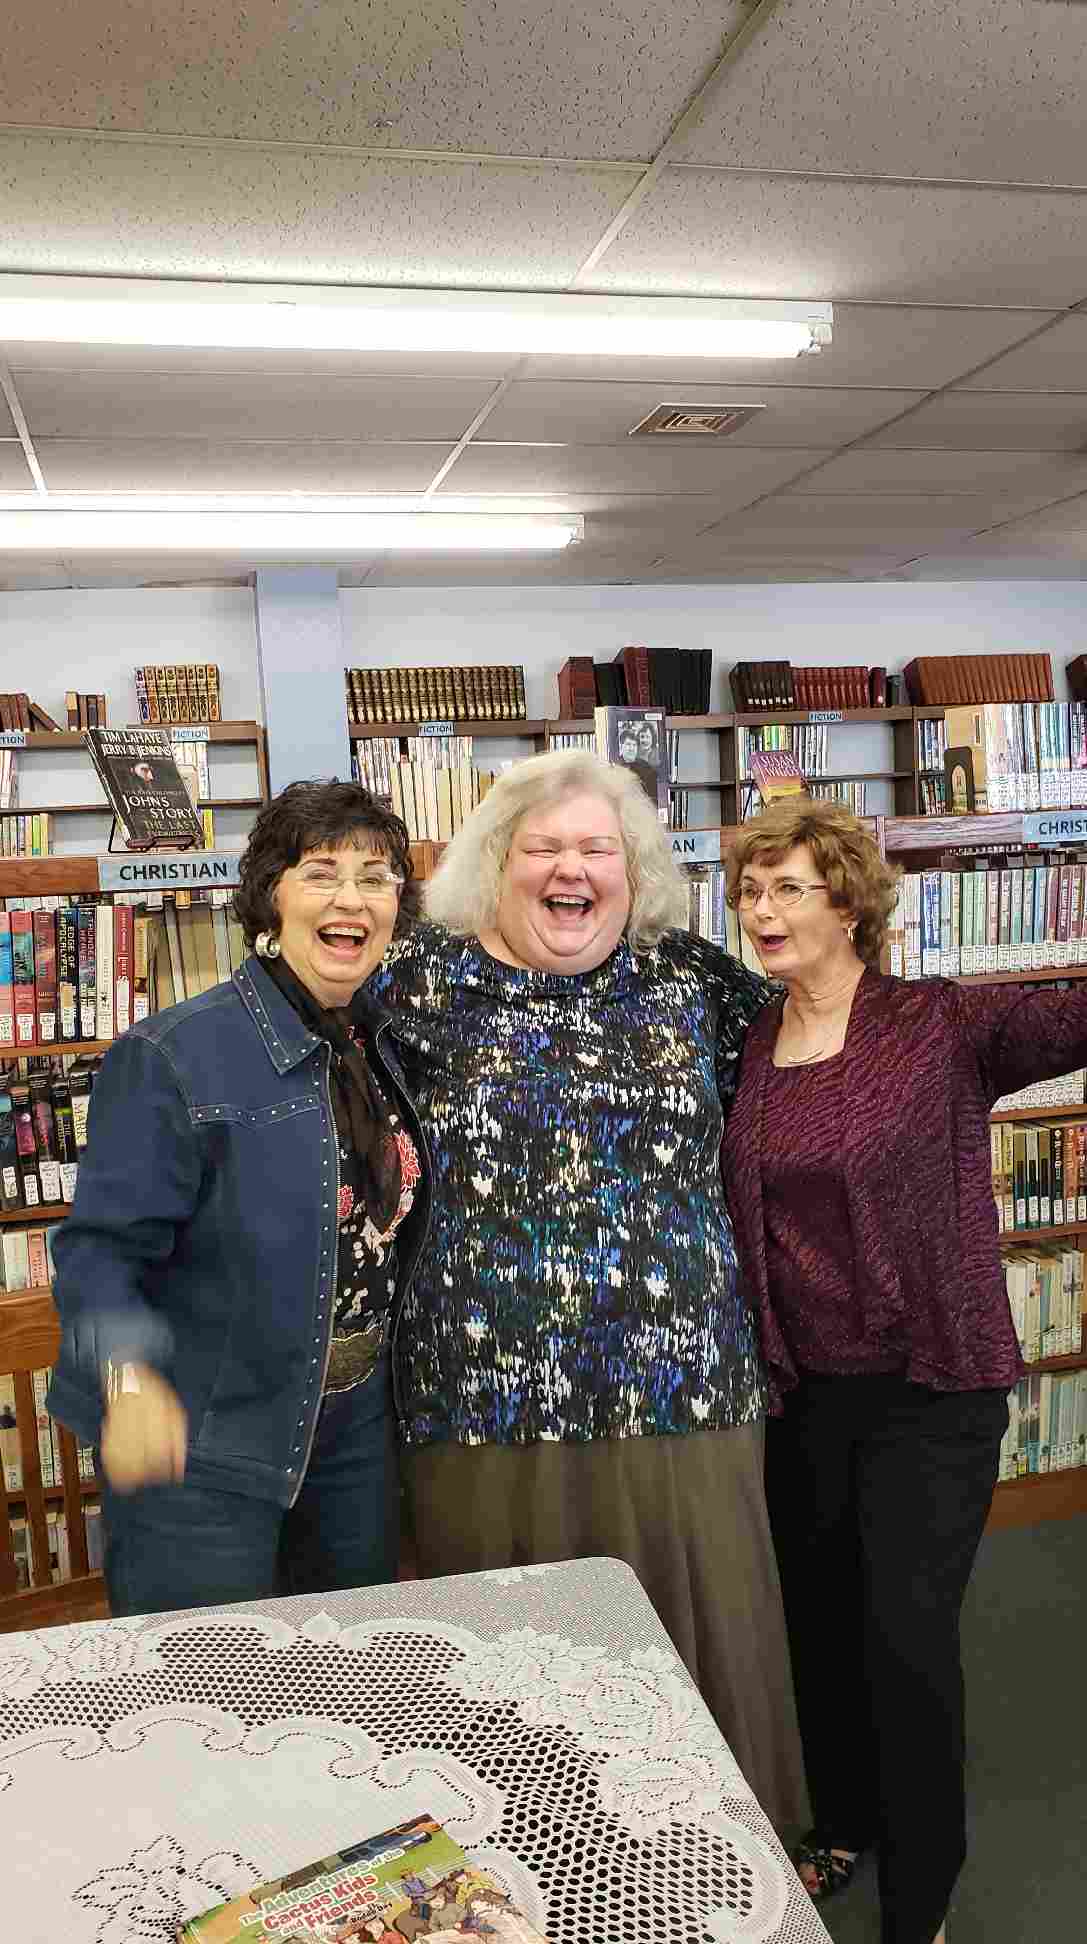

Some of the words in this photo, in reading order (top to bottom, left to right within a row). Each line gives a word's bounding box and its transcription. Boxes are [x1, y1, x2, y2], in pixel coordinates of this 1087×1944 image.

[103, 731, 121, 743] TIM
[101, 743, 127, 756] JERRY
[150, 807, 193, 819] STORY
[119, 861, 228, 881] CHRISTIAN
[59, 917, 67, 977] APOCALYPSE
[67, 926, 75, 953] EDGE
[263, 1891, 332, 1931] Cactus
[331, 1874, 378, 1900] Kids
[303, 1890, 378, 1930] Friends
